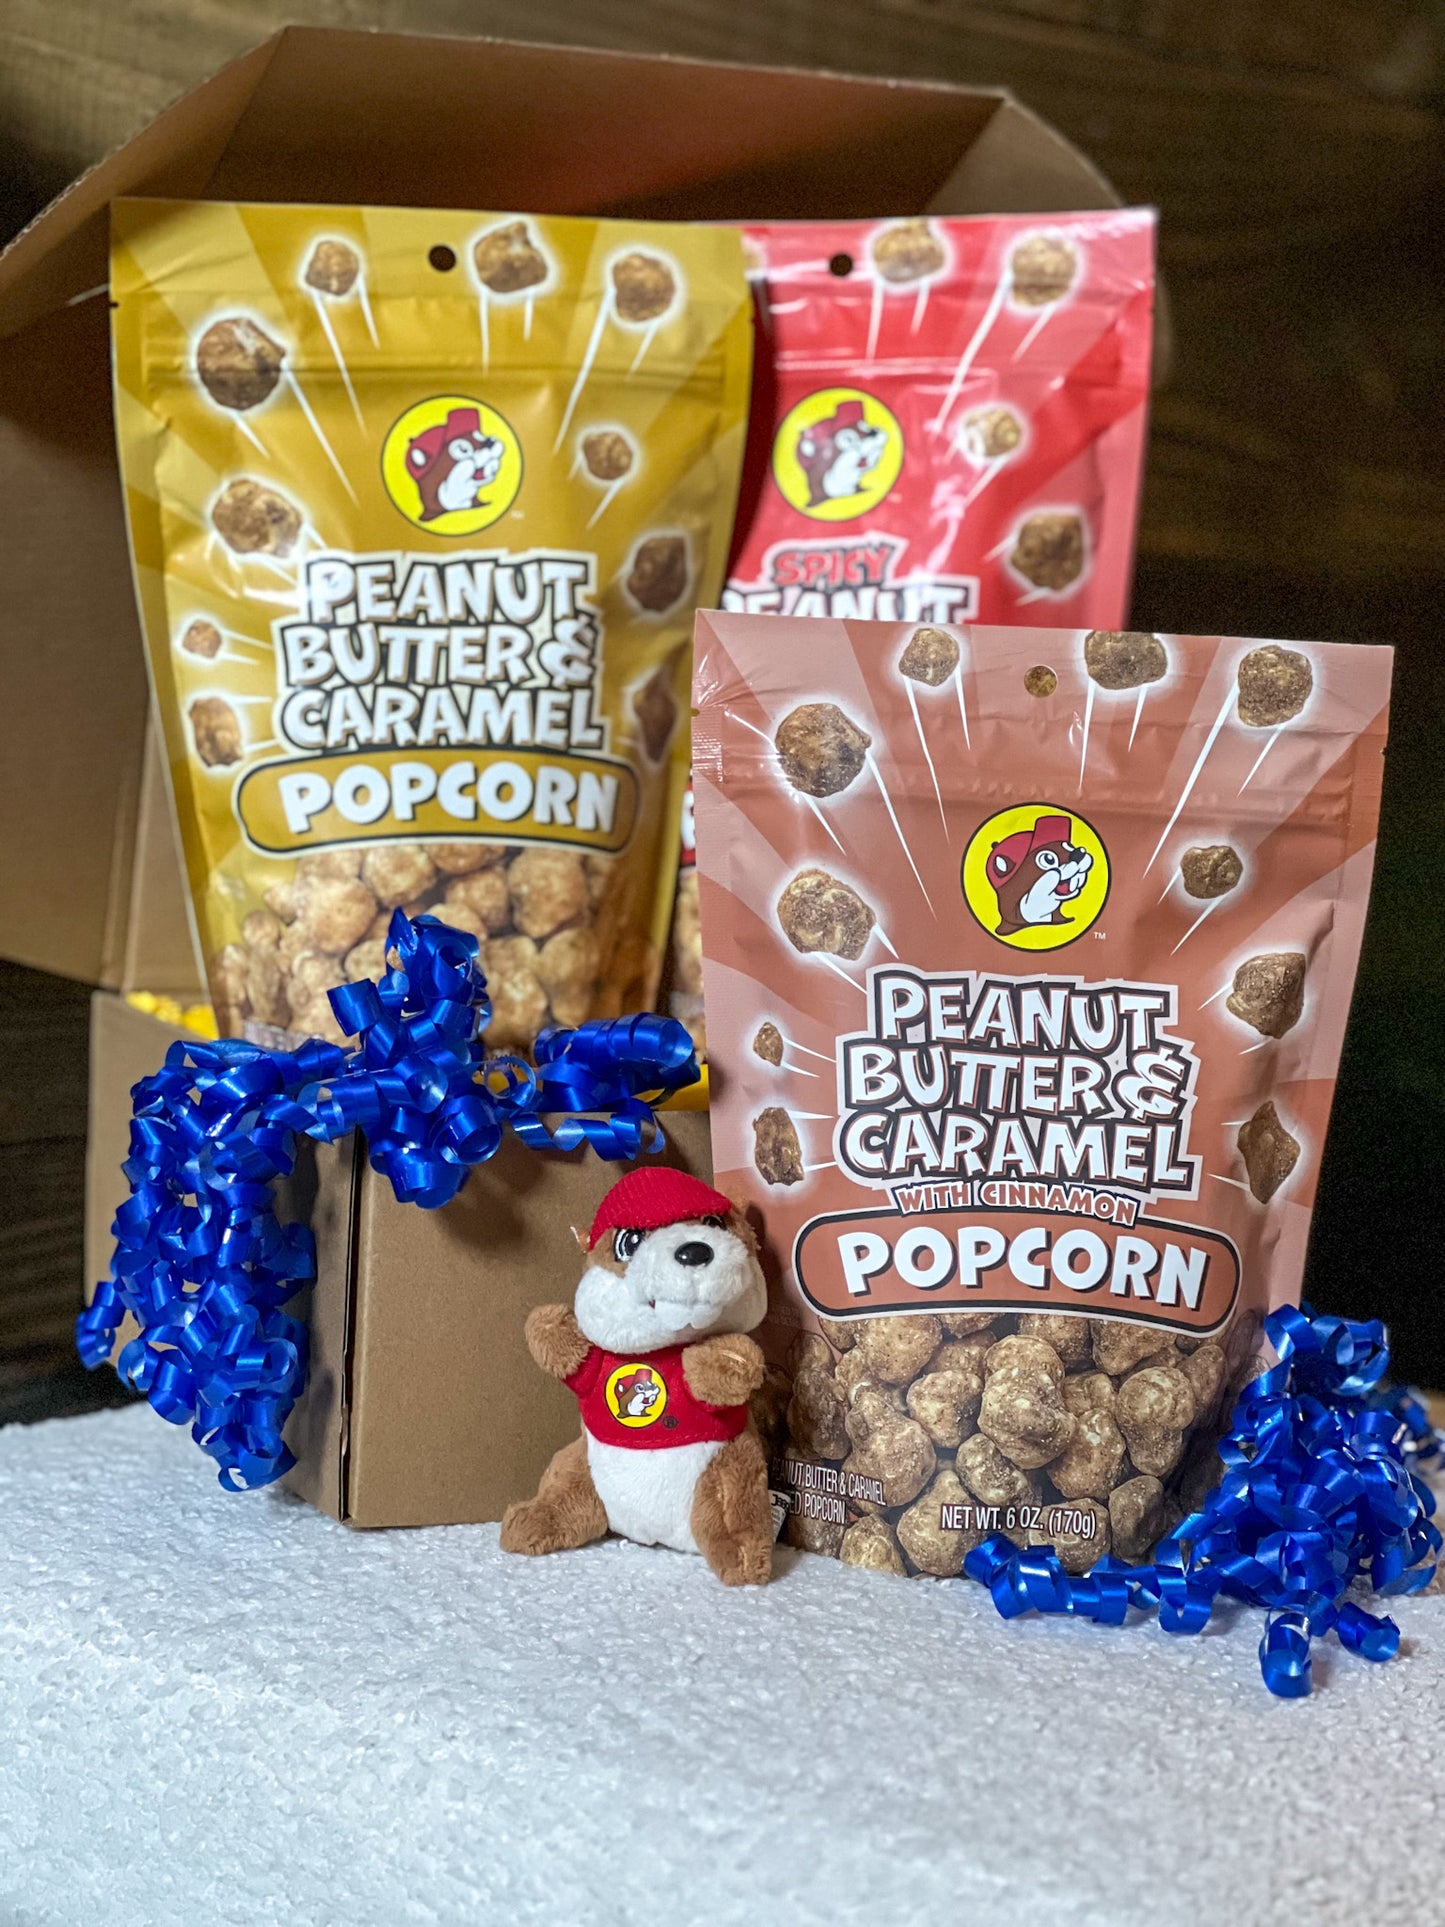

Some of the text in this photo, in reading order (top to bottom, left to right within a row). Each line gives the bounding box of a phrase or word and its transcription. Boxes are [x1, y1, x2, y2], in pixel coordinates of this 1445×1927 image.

[309, 560, 587, 625] PEANUT
[774, 546, 890, 586] SPICY
[282, 613, 597, 689] BUTTER &
[282, 685, 604, 750] CARAMEL
[278, 760, 619, 834] POPCORN
[878, 975, 1165, 1052] PEANUT
[849, 1043, 1186, 1123] BUTTER &
[846, 1111, 1191, 1187] CARAMEL
[896, 1180, 1140, 1228] WITH CINNAMON
[836, 1225, 1208, 1311] POPCORN
[804, 1493, 846, 1524] POPCORN
[805, 1464, 838, 1494] BUTTER
[839, 1471, 847, 1495] &
[848, 1473, 886, 1506] CARAMEL
[941, 1505, 1096, 1539] NET WT. 6 OZ. (170g)
